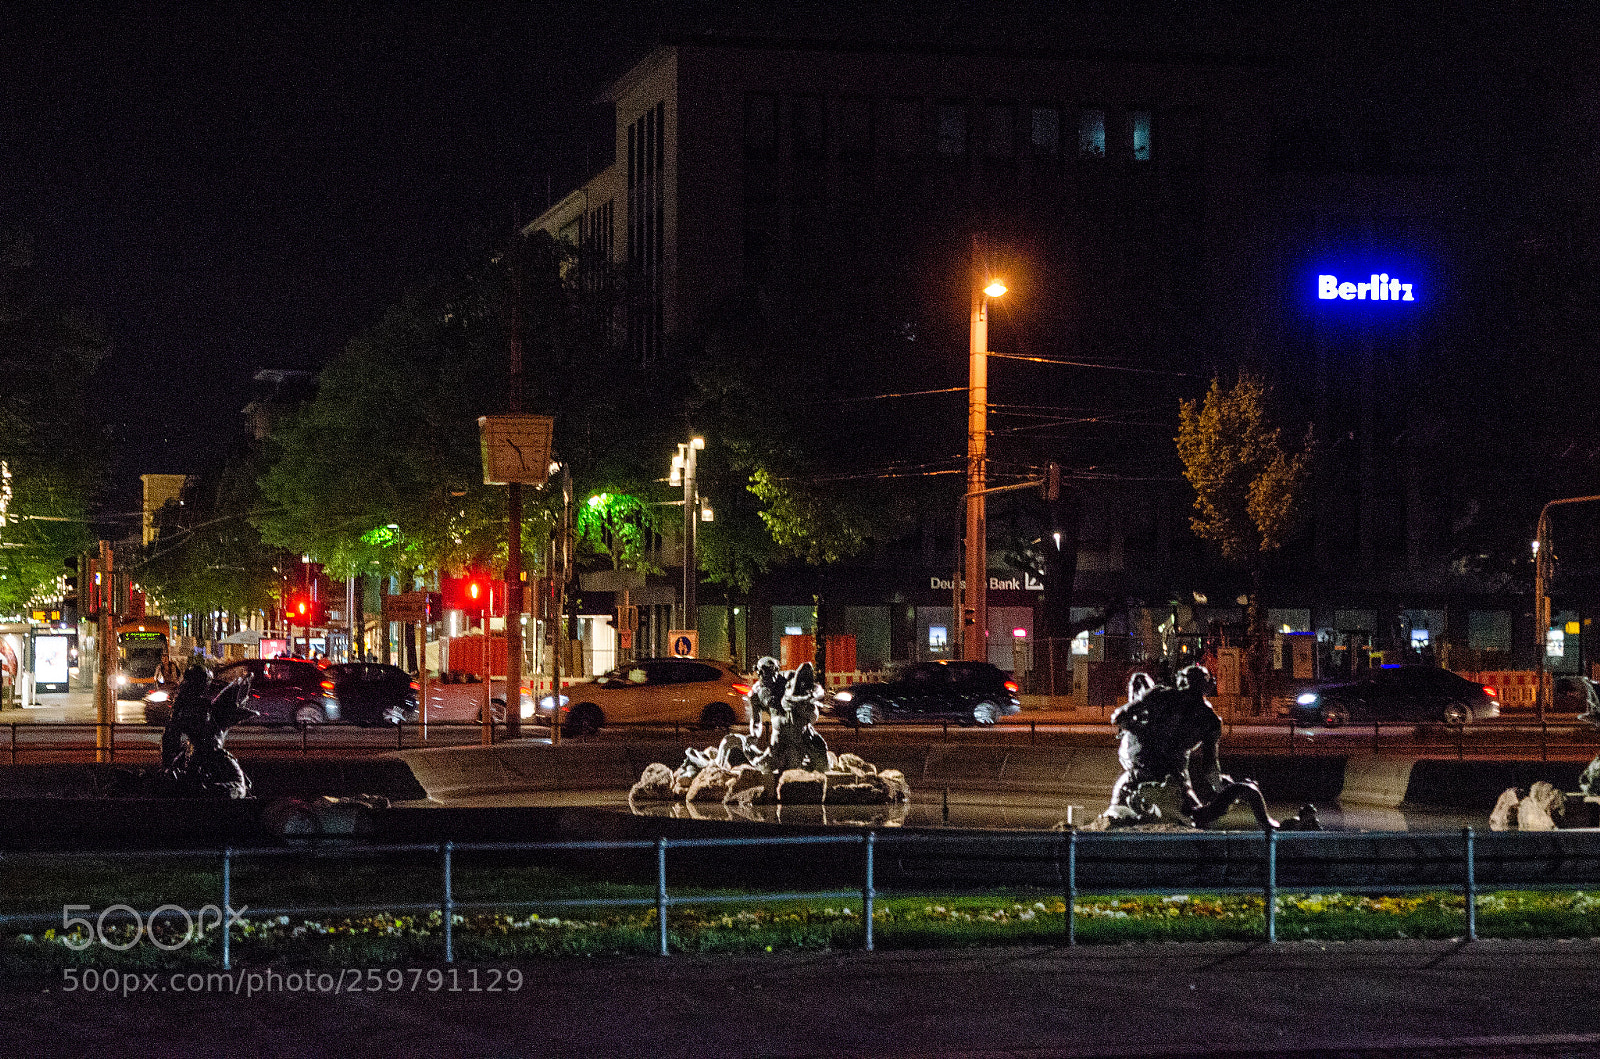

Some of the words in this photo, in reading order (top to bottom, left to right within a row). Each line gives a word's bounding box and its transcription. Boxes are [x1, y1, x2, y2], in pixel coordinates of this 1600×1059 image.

[1318, 273, 1415, 301] Berlitz
[930, 577, 987, 591] Deus
[989, 577, 1021, 591] Bank
